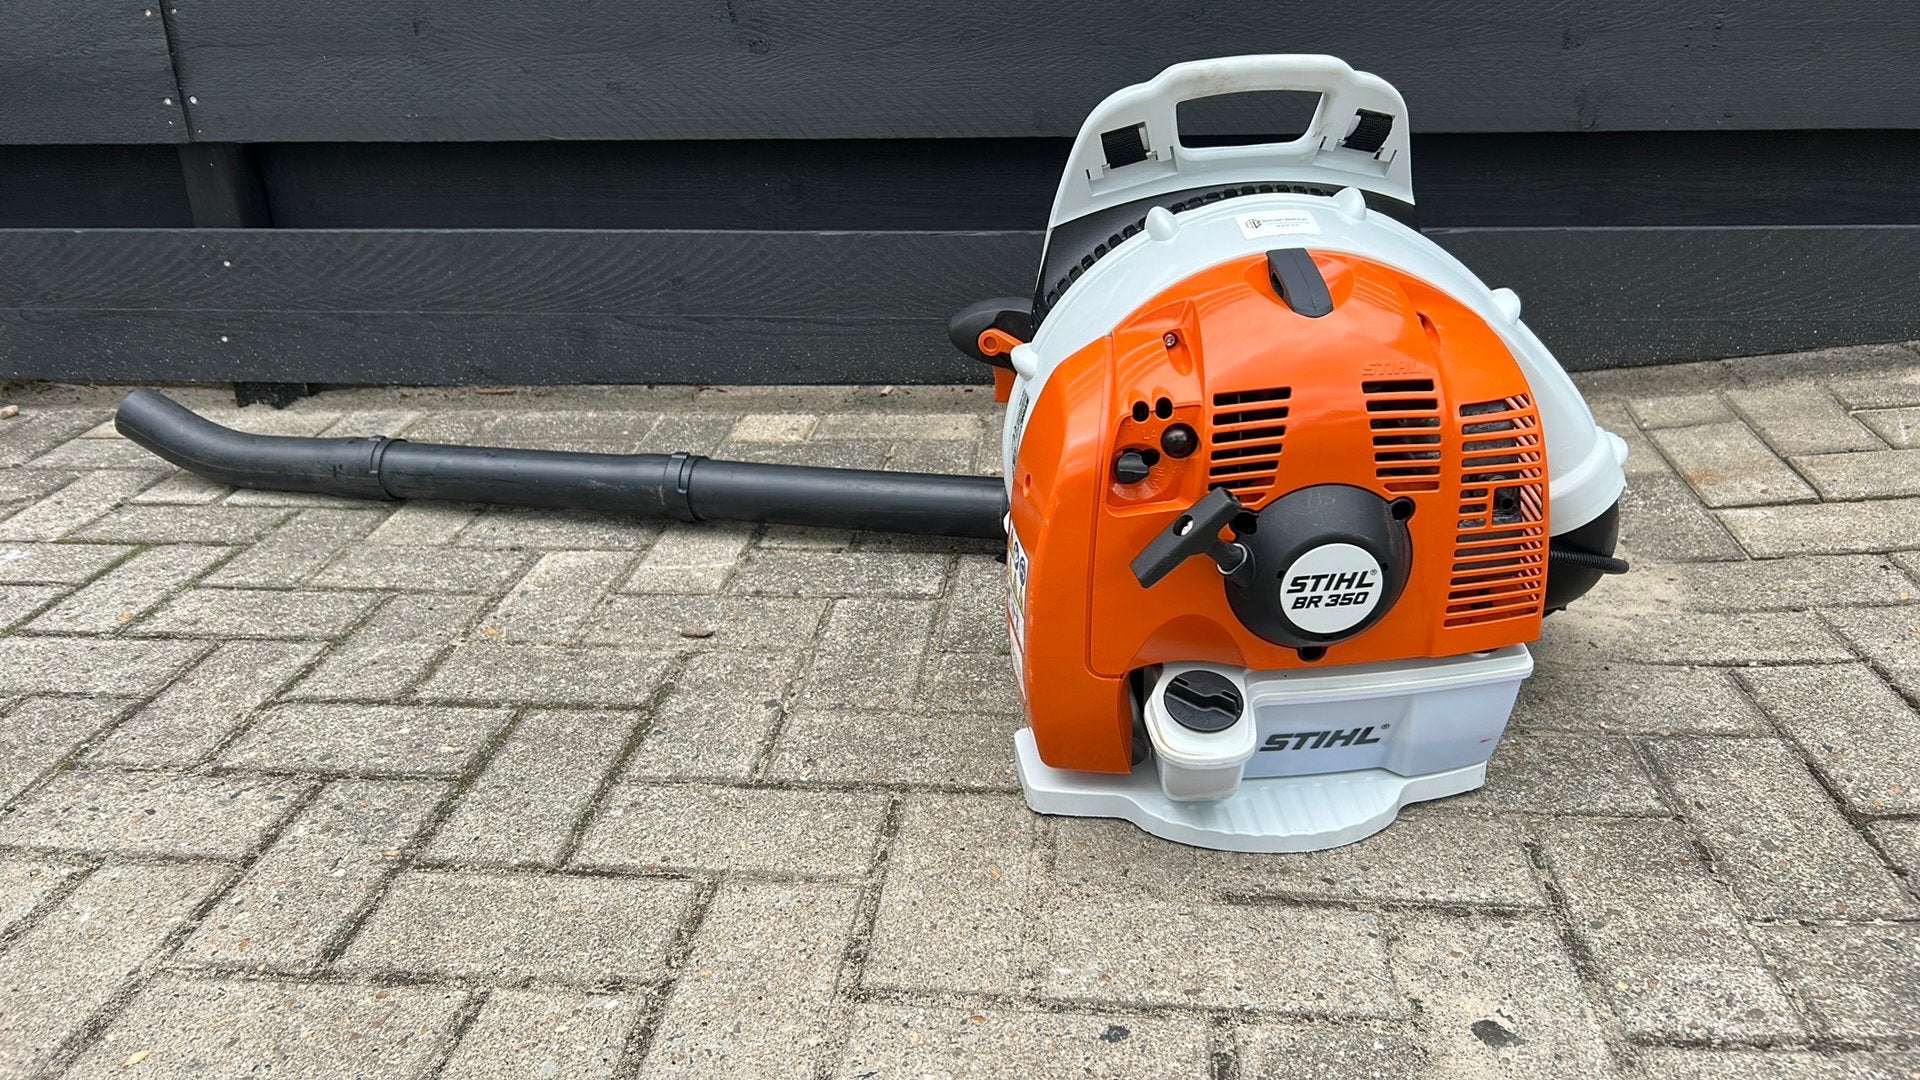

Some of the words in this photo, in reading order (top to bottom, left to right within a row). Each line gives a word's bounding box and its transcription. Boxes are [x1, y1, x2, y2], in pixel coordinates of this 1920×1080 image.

[1362, 360, 1423, 376] STIHL
[1286, 570, 1374, 594] STIHL
[1291, 595, 1323, 610] BR
[1324, 591, 1369, 607] 350
[1259, 726, 1381, 752] STIHL
